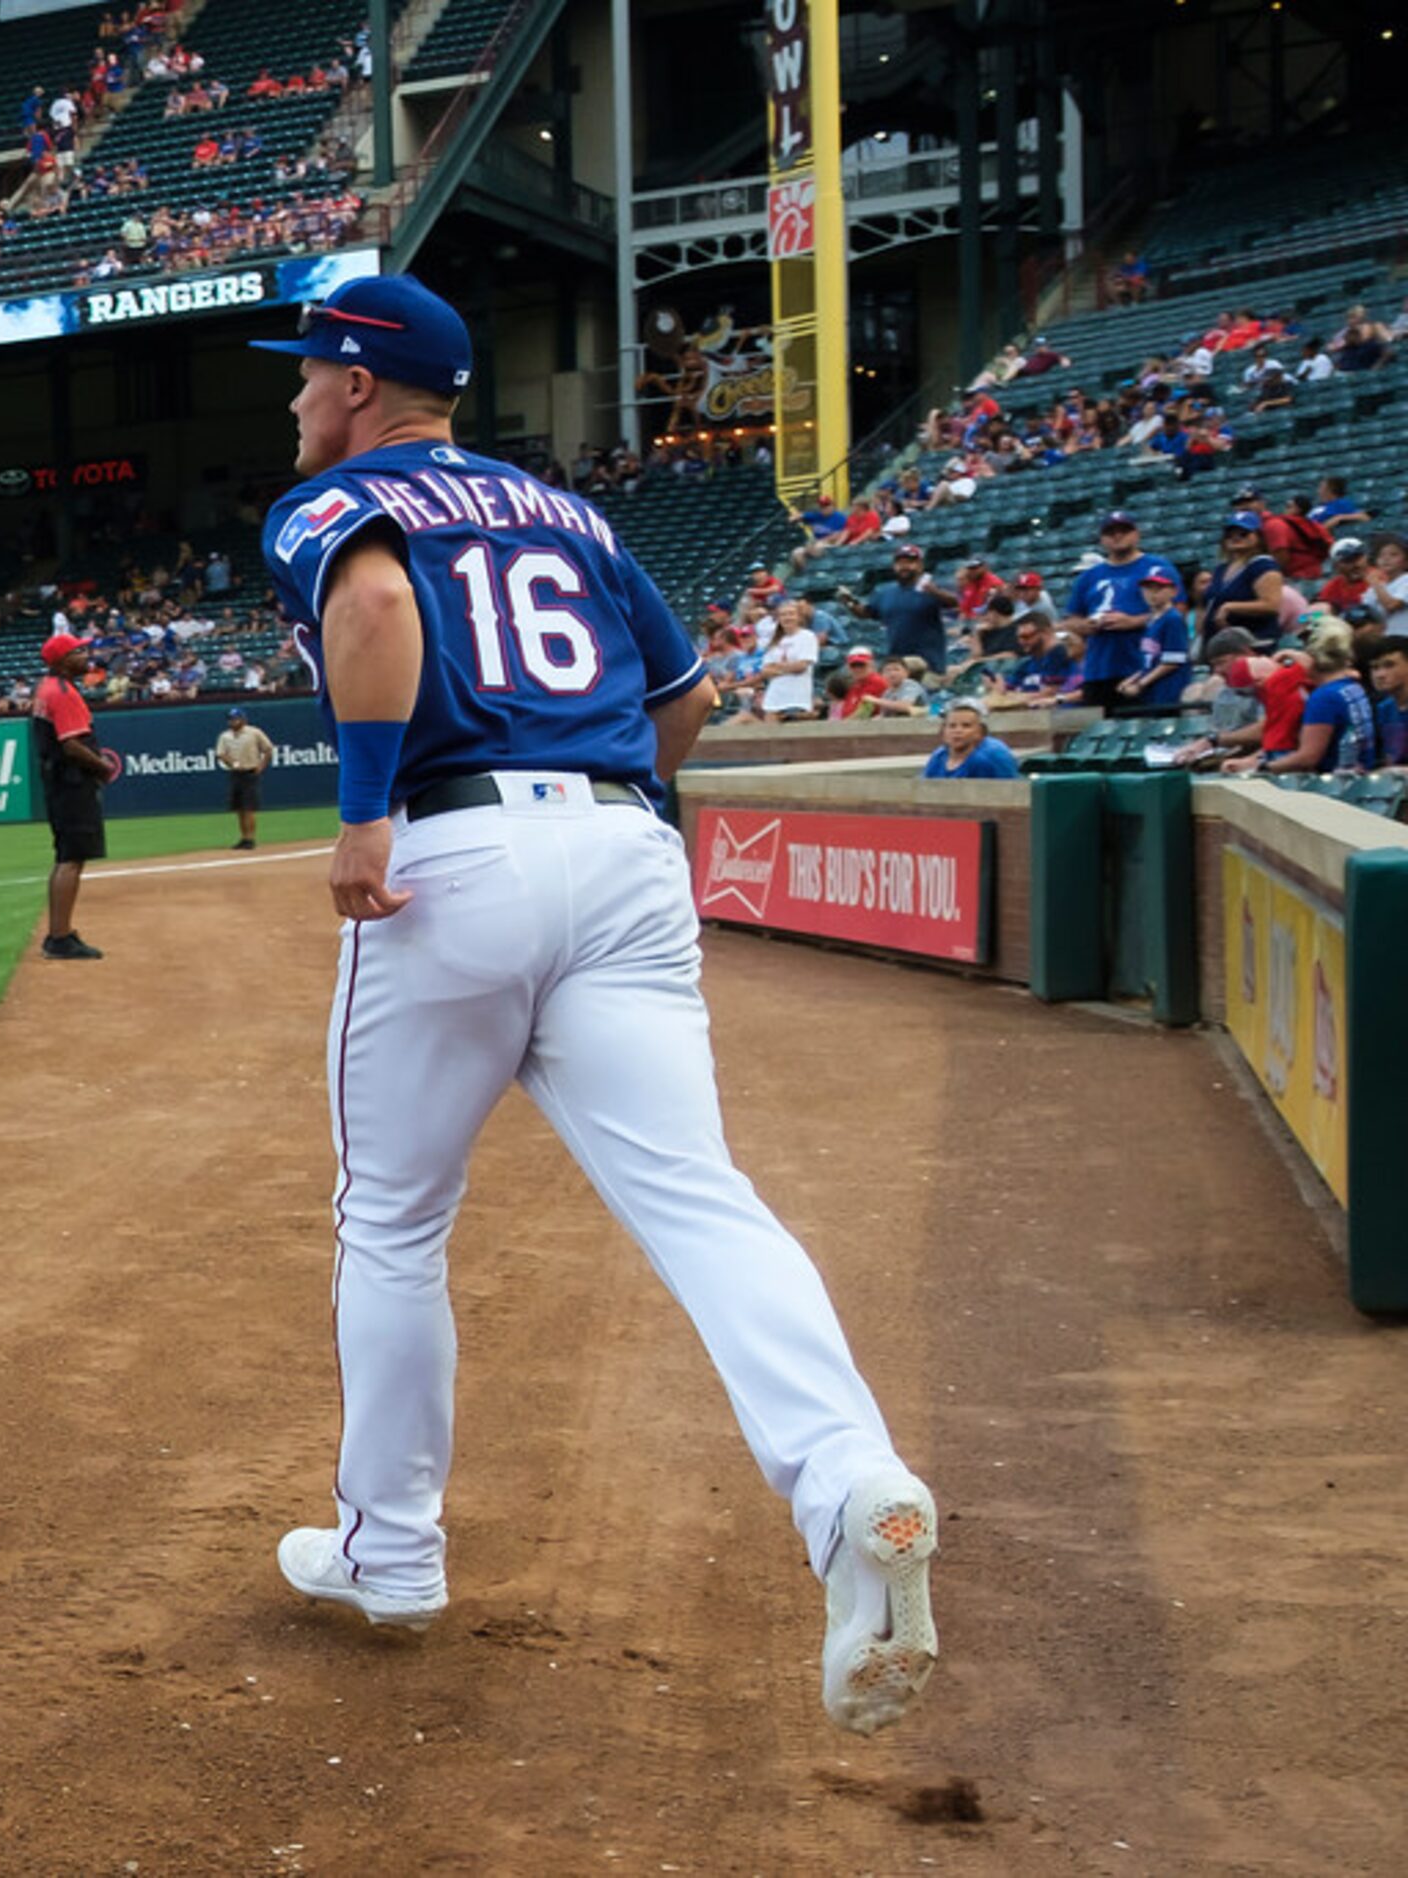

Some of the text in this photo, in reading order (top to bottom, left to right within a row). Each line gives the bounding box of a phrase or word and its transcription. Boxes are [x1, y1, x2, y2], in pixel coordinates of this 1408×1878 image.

[88, 273, 264, 323] RANGERS
[449, 540, 603, 695] 16
[125, 749, 215, 776] Medical
[272, 742, 340, 768] Healt
[787, 843, 962, 922] THIS BUD'S FOR YOU.
